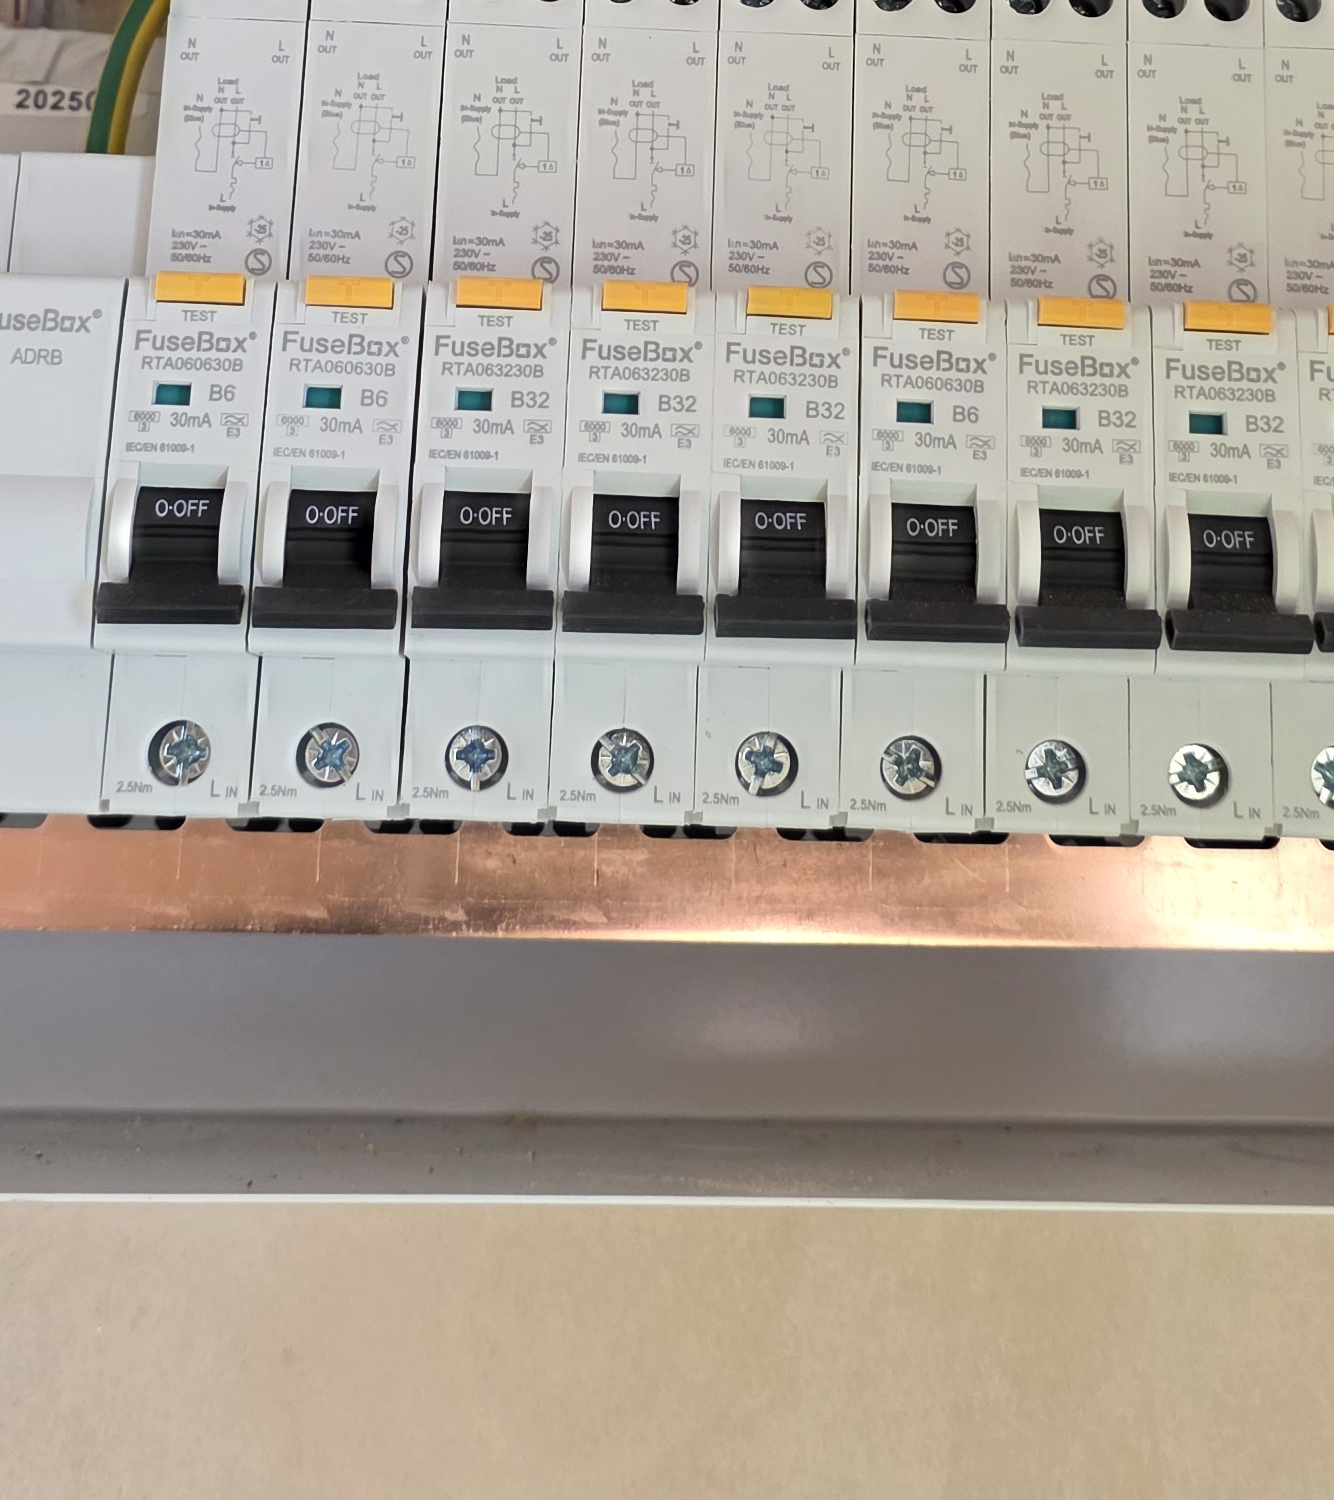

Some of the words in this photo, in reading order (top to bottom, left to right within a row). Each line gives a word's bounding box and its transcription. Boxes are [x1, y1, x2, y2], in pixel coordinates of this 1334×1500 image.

[182, 310, 217, 322] TEST
[331, 311, 368, 324] TEST
[478, 315, 514, 327] TEST
[624, 319, 659, 332] TEST
[770, 322, 806, 337] TEST
[919, 327, 955, 342] TEST
[1060, 334, 1095, 347] TEST
[1206, 338, 1242, 351] TEST
[11, 348, 63, 366] ADRB
[141, 356, 243, 372] RTA060630B
[289, 358, 396, 377] RTA060630B
[441, 362, 544, 379] RTA063230B
[589, 366, 691, 382] RTA063230B
[734, 369, 839, 389] RTA063230B
[881, 373, 985, 393] RTA060630B
[209, 384, 236, 401] B6
[1027, 380, 1129, 398] RTA063230B
[1174, 385, 1276, 402] RTA063230B
[360, 389, 389, 407] B6
[511, 391, 550, 409] B32
[658, 395, 697, 413] B32
[806, 401, 845, 420] B32
[952, 405, 979, 424] B6
[1098, 410, 1137, 428] B32
[170, 412, 212, 428] 30mA
[320, 417, 363, 434] 30mA
[473, 419, 515, 435] 30mA
[1245, 415, 1285, 433] B32
[620, 423, 662, 439] 30mA
[767, 428, 810, 446] 30mA
[914, 432, 957, 450] 30mA
[1062, 438, 1104, 454] 30mA
[1209, 442, 1251, 459] 30mA
[116, 781, 153, 794] 2.5Nm
[211, 781, 220, 798] L
[226, 787, 238, 798] IN
[560, 790, 596, 802] 2.5Nm
